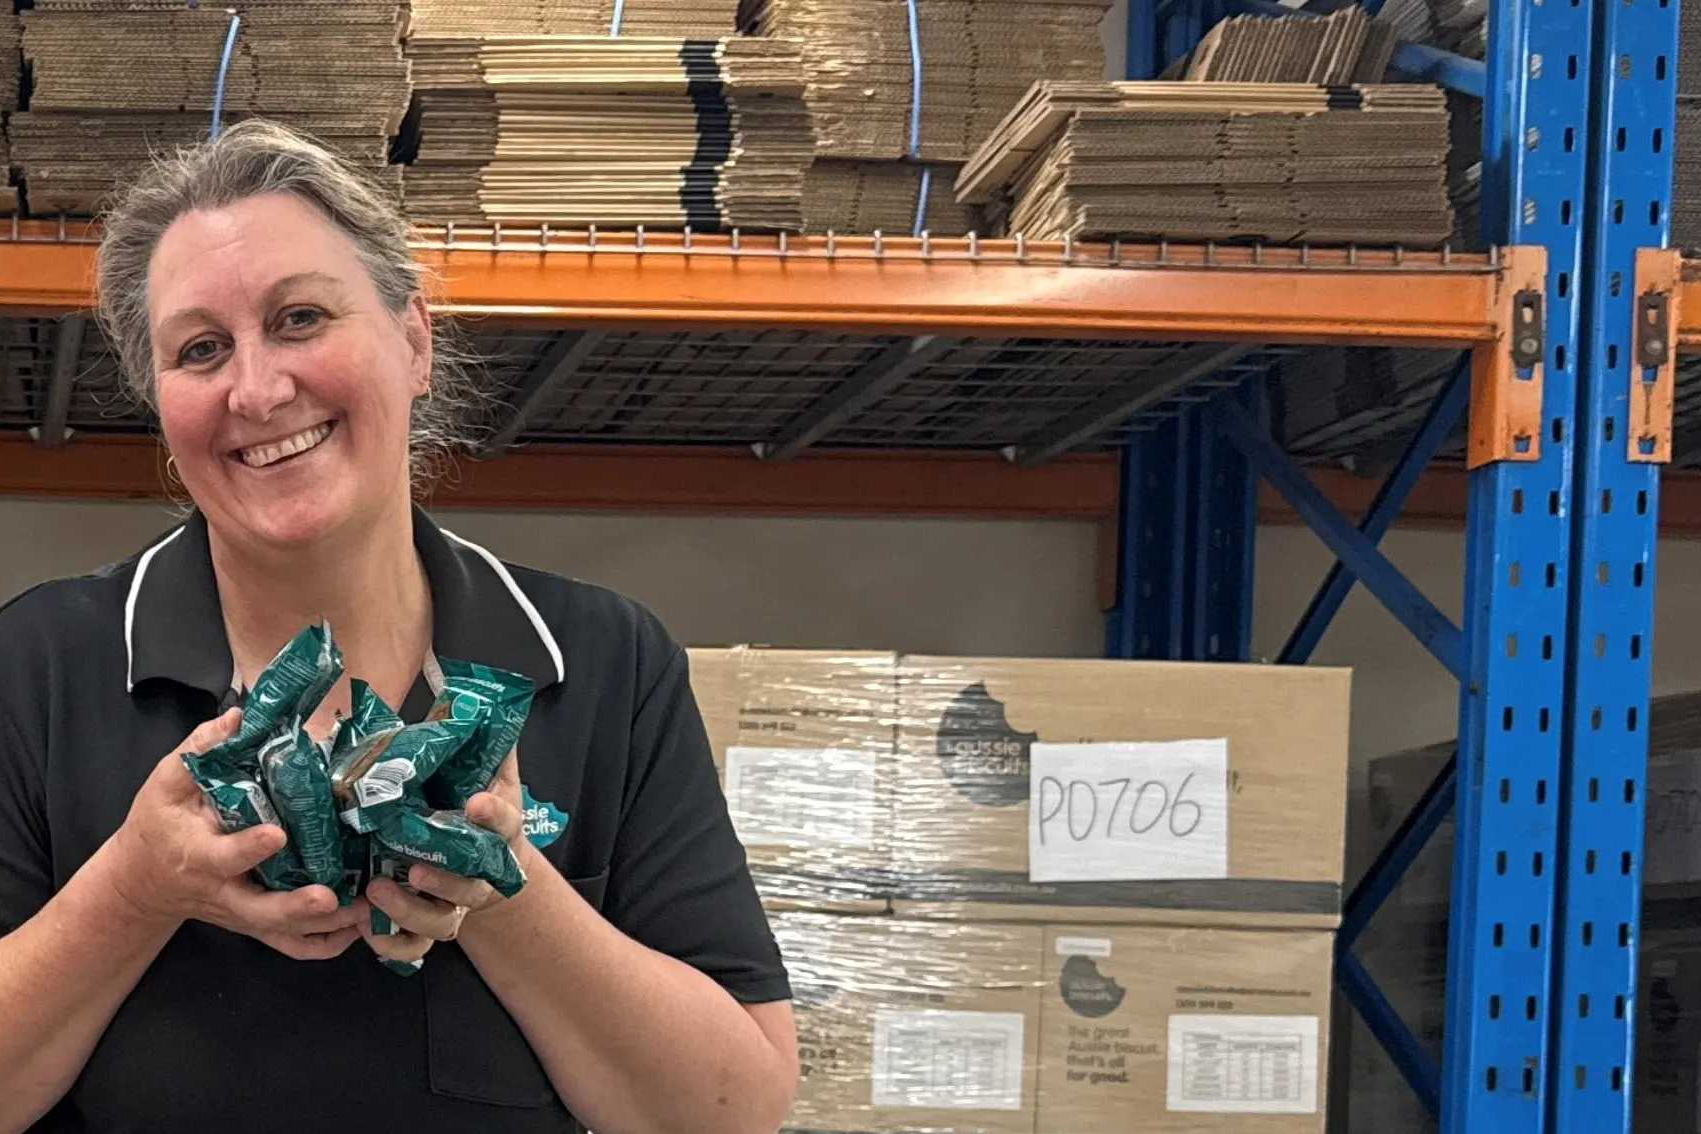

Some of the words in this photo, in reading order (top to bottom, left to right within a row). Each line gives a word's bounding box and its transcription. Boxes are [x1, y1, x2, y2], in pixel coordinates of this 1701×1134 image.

[954, 737, 1020, 756] aussie
[405, 846, 447, 864] biscuits
[1067, 1070, 1086, 1082] for
